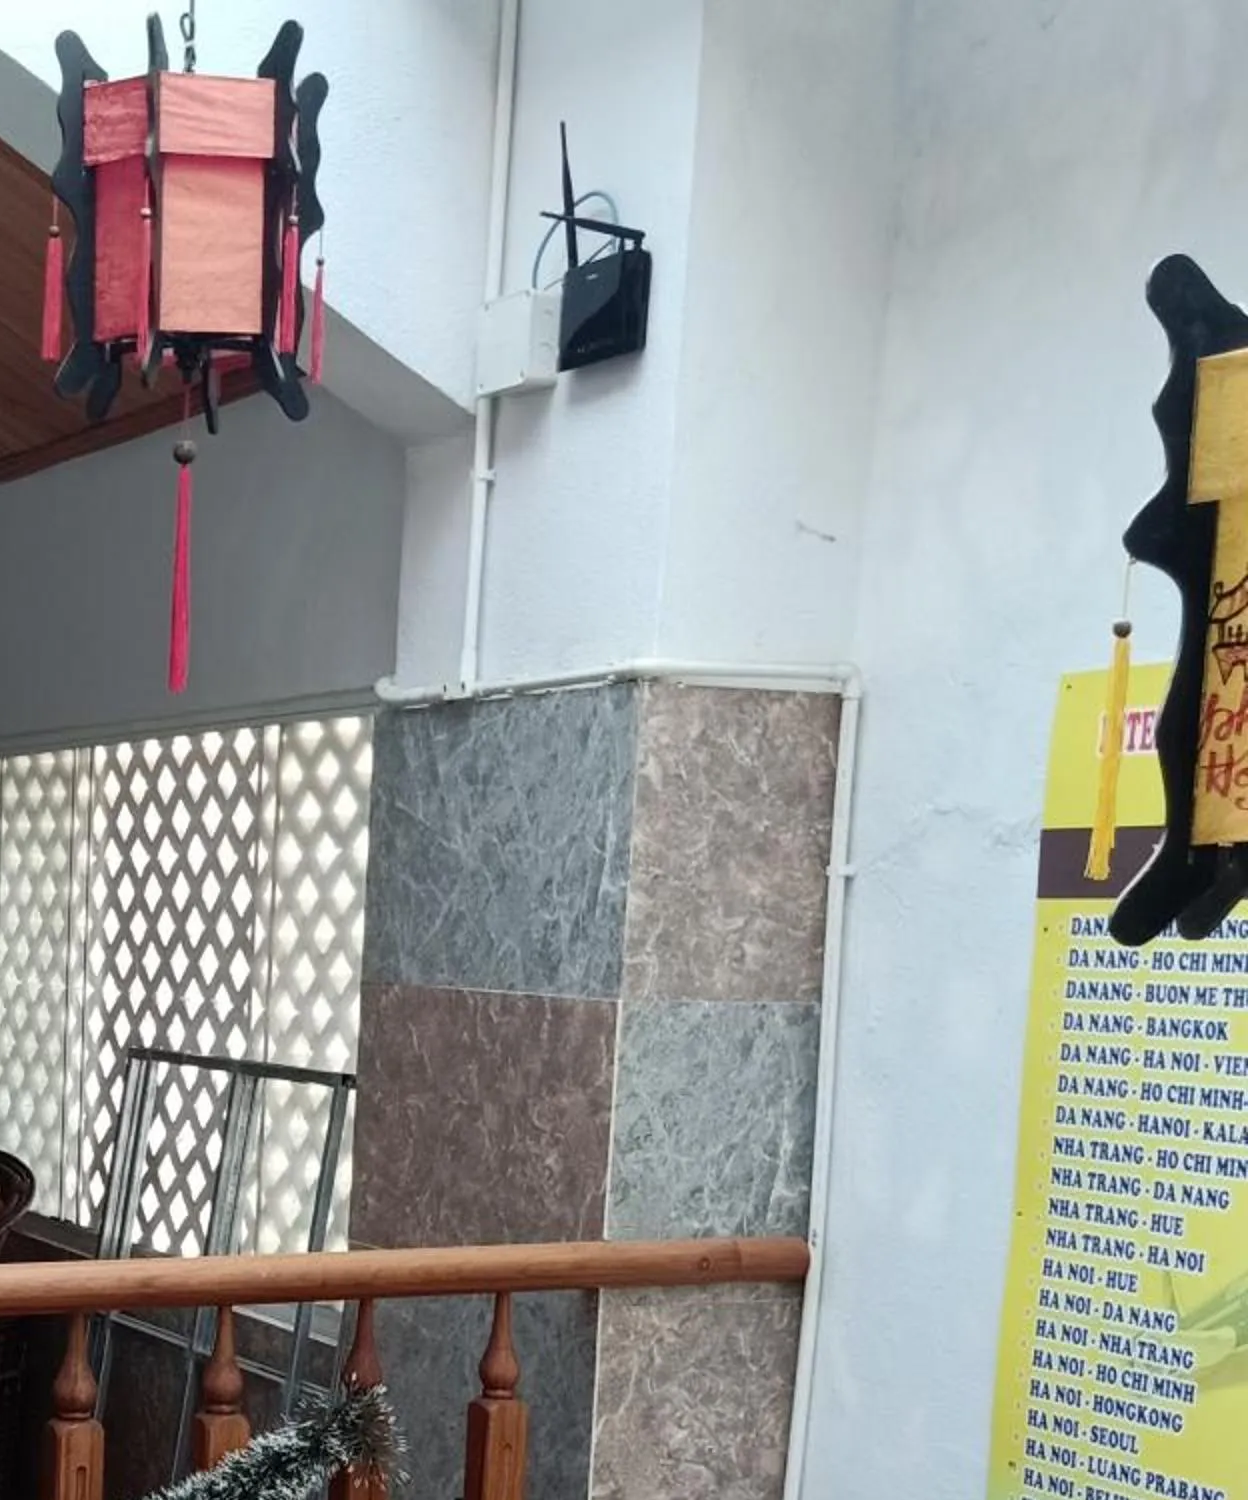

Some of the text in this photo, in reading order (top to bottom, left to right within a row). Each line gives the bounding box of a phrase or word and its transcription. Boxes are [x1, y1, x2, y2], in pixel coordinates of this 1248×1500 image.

[1069, 949, 1089, 968] DA
[1095, 951, 1139, 969] NANG
[1152, 951, 1174, 970] HO
[1179, 952, 1207, 971] CHI
[1066, 981, 1132, 1001] DANANG
[1145, 984, 1190, 1004] BUON
[1195, 987, 1218, 1006] ME
[1064, 1012, 1228, 1041] DA NANG BANGKOK
[1061, 1043, 1081, 1062] DA
[1086, 1046, 1131, 1066] NANG
[1144, 1050, 1165, 1069] HA
[1171, 1052, 1200, 1072] NOI
[1057, 1075, 1078, 1094] DA
[1083, 1077, 1128, 1098] NANG
[1140, 1082, 1163, 1101] HO
[1167, 1085, 1195, 1105] CHI
[1055, 1106, 1076, 1125] DA
[1081, 1108, 1125, 1130] NANG
[1138, 1114, 1191, 1137] HANOI
[1053, 1136, 1084, 1158] NHA
[1090, 1141, 1144, 1165] TRANG
[1156, 1149, 1179, 1169] HO
[1183, 1153, 1211, 1173] CHI
[1051, 1167, 1229, 1208] NHA TRANG DA NANG
[1049, 1198, 1184, 1236] NHA TRANG HUE
[1045, 1228, 1205, 1272] NHA TRANG HA NOI
[1043, 1259, 1138, 1293] HA NOI HUE
[1039, 1289, 1175, 1333] HA NOI DA NANG
[1035, 1319, 1194, 1369] HA NOI NHA TRANG
[1032, 1350, 1195, 1403] HA NOI HO CHI MINH
[1030, 1379, 1183, 1433] HA NOI HONGKONG
[1027, 1409, 1139, 1454] HA NOI SEOUL
[1025, 1438, 1046, 1460] HA
[1050, 1445, 1077, 1468] NOI
[1088, 1455, 1141, 1486] LUANG
[1023, 1468, 1043, 1490] HA
[1047, 1474, 1074, 1498] NOI
